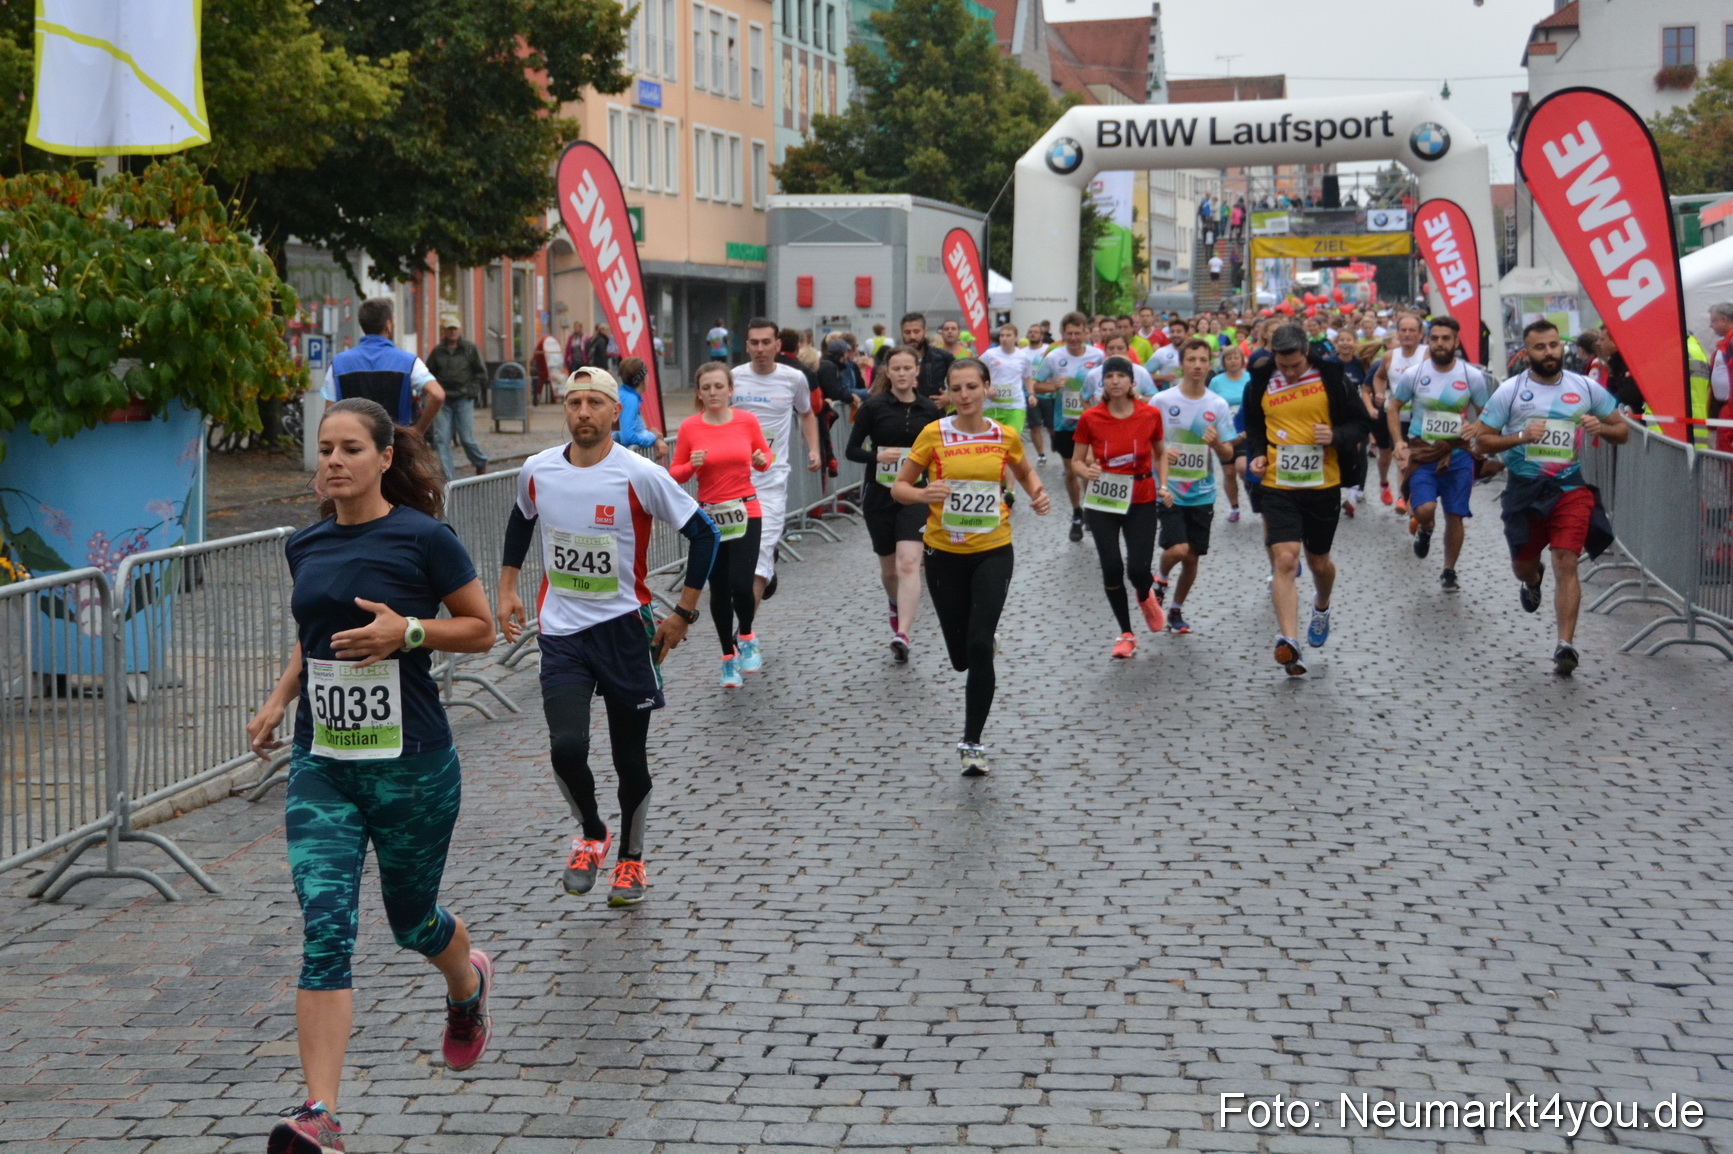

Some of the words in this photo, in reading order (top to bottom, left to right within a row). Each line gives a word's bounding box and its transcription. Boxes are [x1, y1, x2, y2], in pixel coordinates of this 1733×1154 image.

[1097, 118, 1198, 148] BMW
[1210, 110, 1394, 148] Laufsport
[1313, 240, 1349, 253] ZIEL
[311, 341, 320, 357] P
[995, 389, 1012, 398] 323
[1269, 392, 1297, 407] MAX
[1302, 383, 1326, 397] BÖG
[1065, 398, 1082, 409] 50
[1426, 419, 1459, 434] 5202
[944, 446, 971, 457] MAX
[1281, 454, 1320, 471] 5242
[1092, 480, 1128, 499] 5088
[950, 493, 996, 513] 5222
[960, 517, 983, 526] Judith
[554, 545, 612, 575] 5243
[572, 578, 590, 590] Tilo
[315, 684, 391, 722] 5033
[325, 730, 378, 746] Christian
